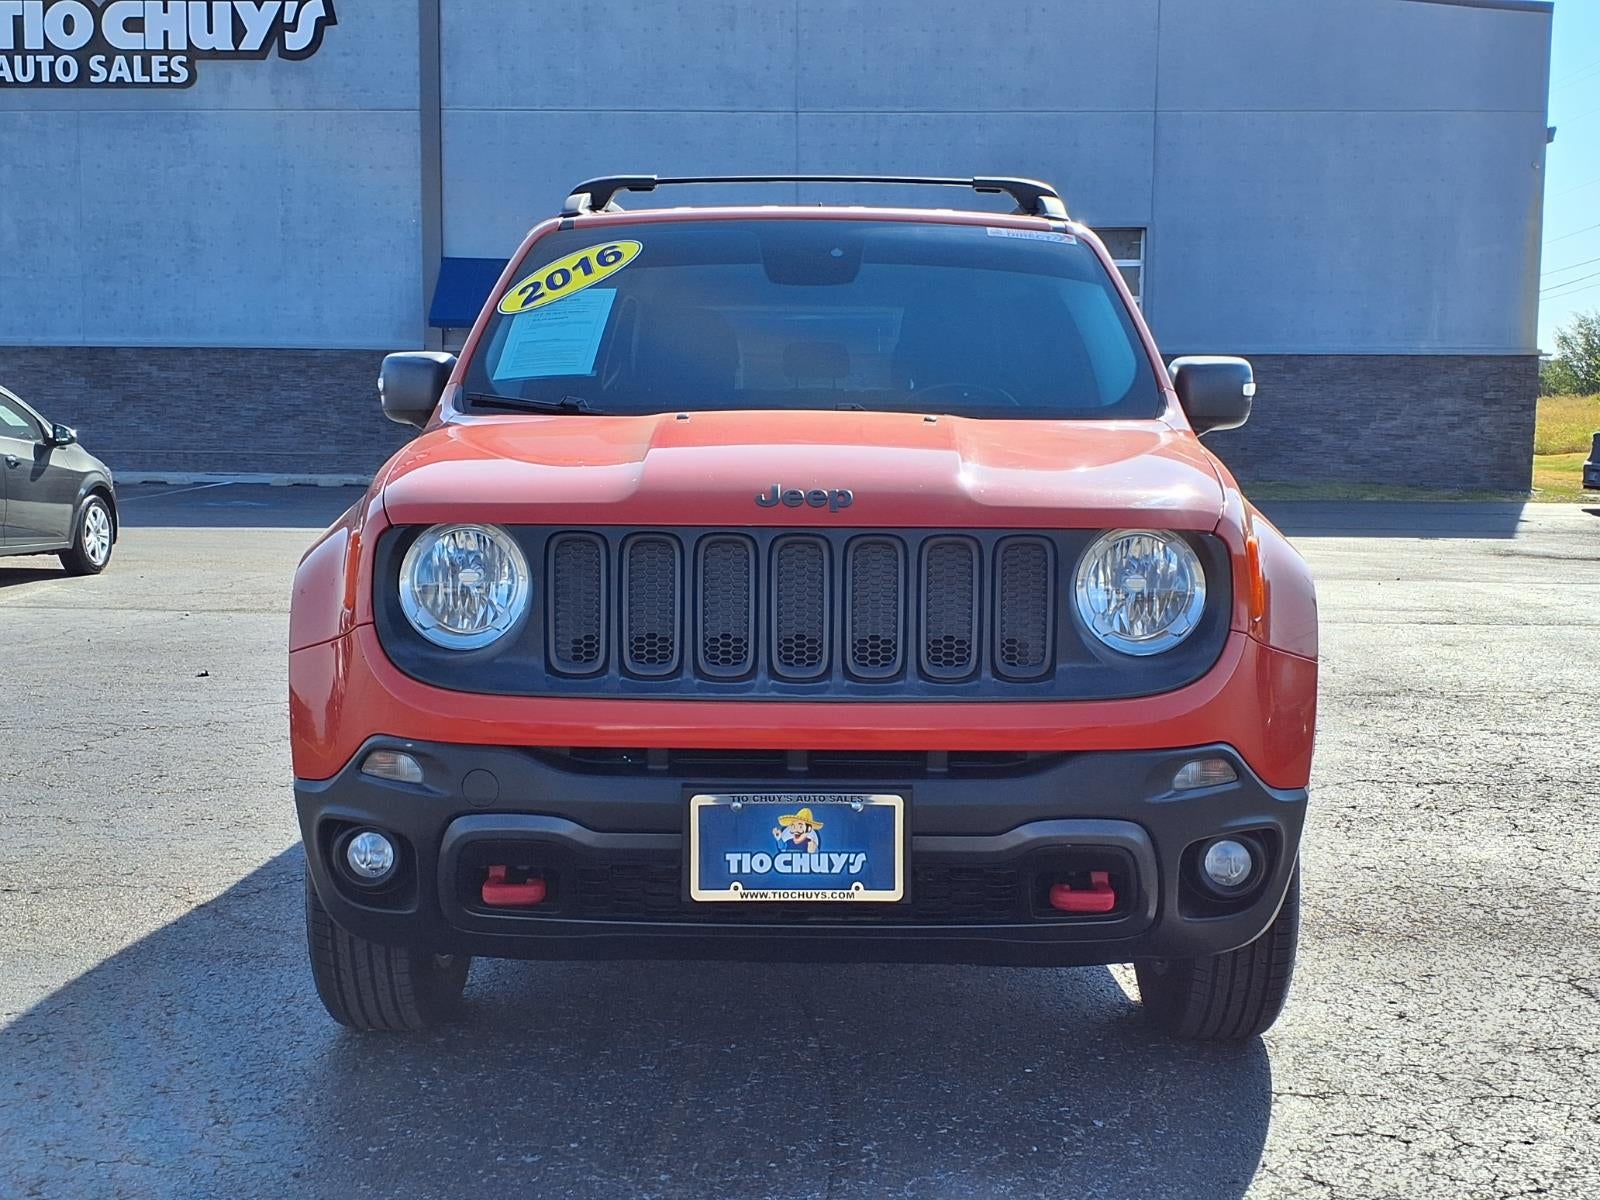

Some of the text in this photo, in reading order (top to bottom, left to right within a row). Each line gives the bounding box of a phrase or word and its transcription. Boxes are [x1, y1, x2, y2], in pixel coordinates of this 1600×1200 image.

[0, 0, 326, 51] TIO CHUY'S
[89, 55, 189, 83] SALES
[517, 245, 623, 308] 2016
[755, 483, 853, 512] Jeep
[731, 795, 864, 803] TIO CHUY'S AUTO SALES
[725, 853, 867, 874] TIO CHUY'S
[739, 891, 855, 900] WWW.TIOCHUYS.COM
